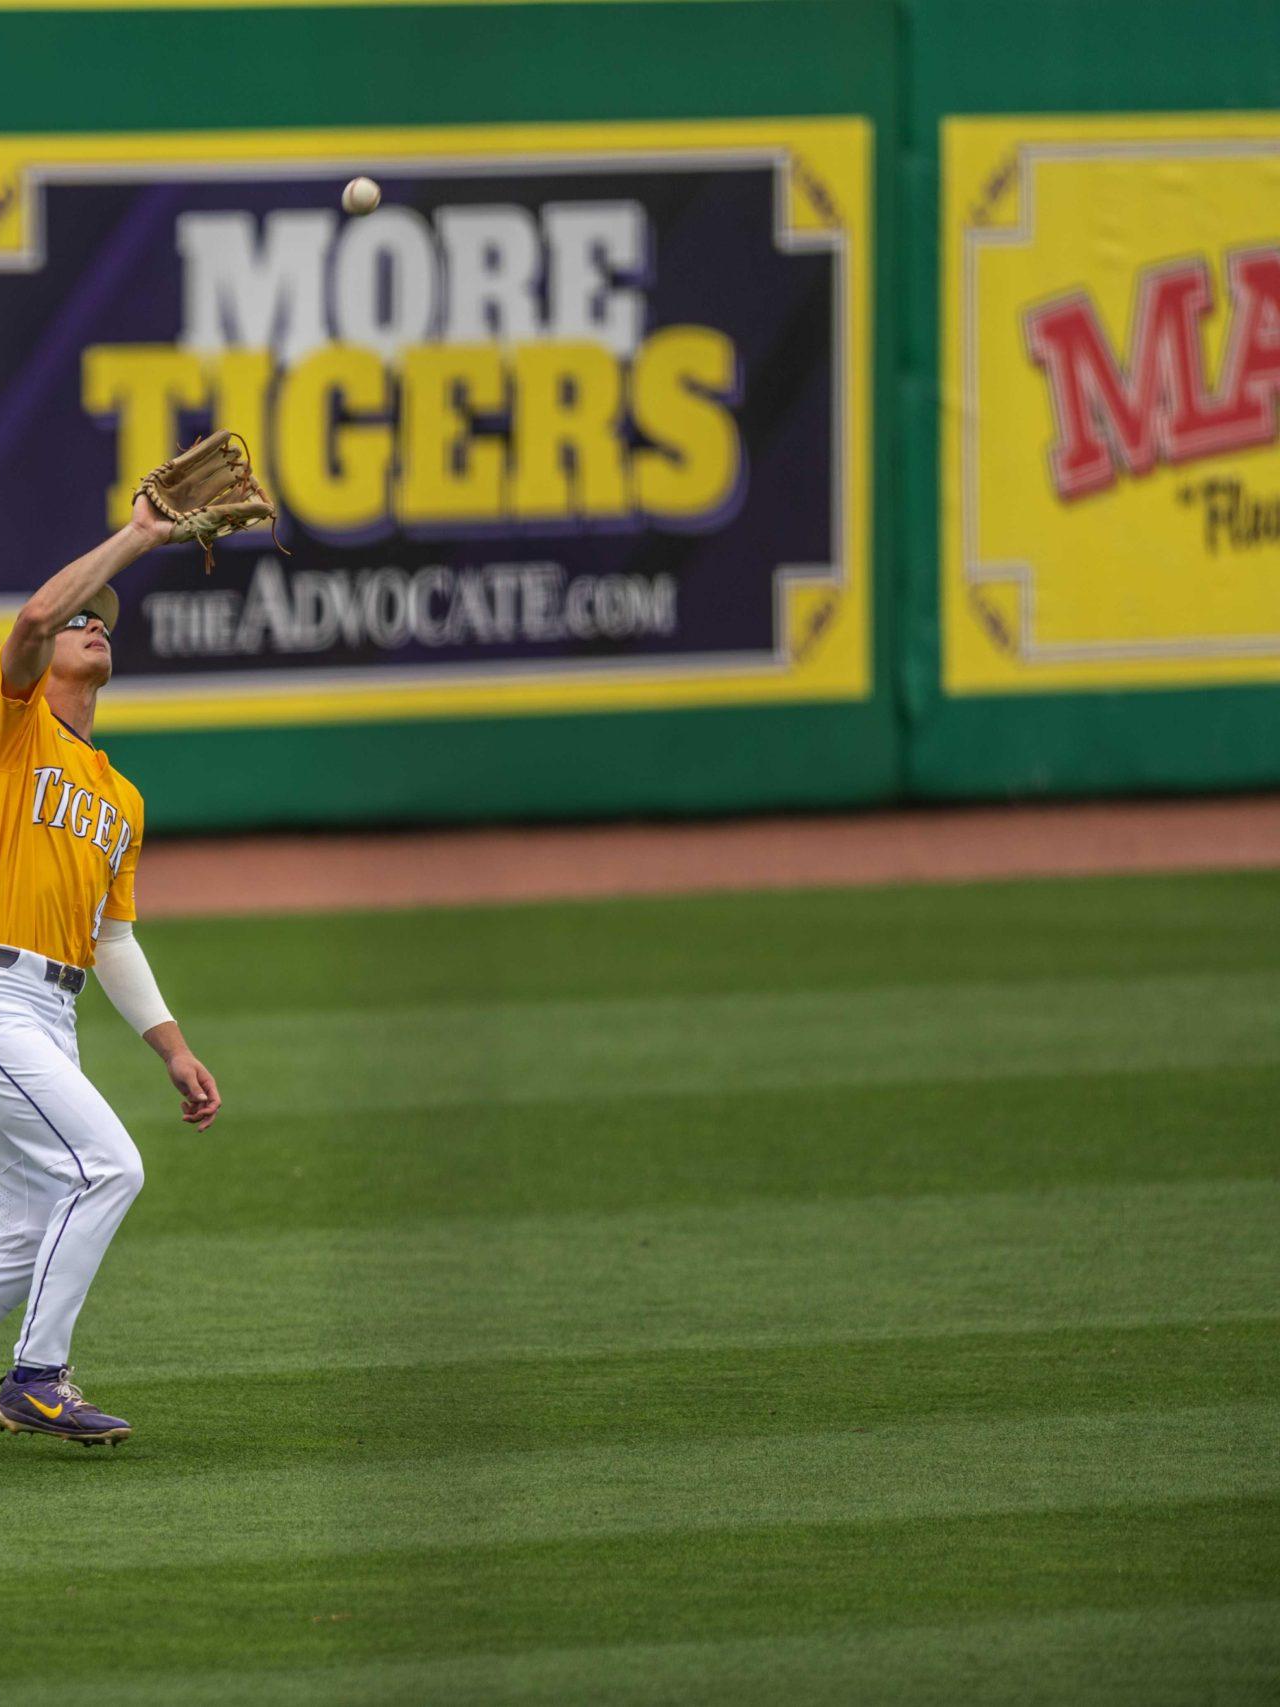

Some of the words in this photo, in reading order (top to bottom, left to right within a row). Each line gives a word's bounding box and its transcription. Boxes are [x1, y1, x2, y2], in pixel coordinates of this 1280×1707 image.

[177, 200, 648, 362] MORE
[81, 324, 746, 538] TIGERS
[33, 766, 131, 881] TIGER
